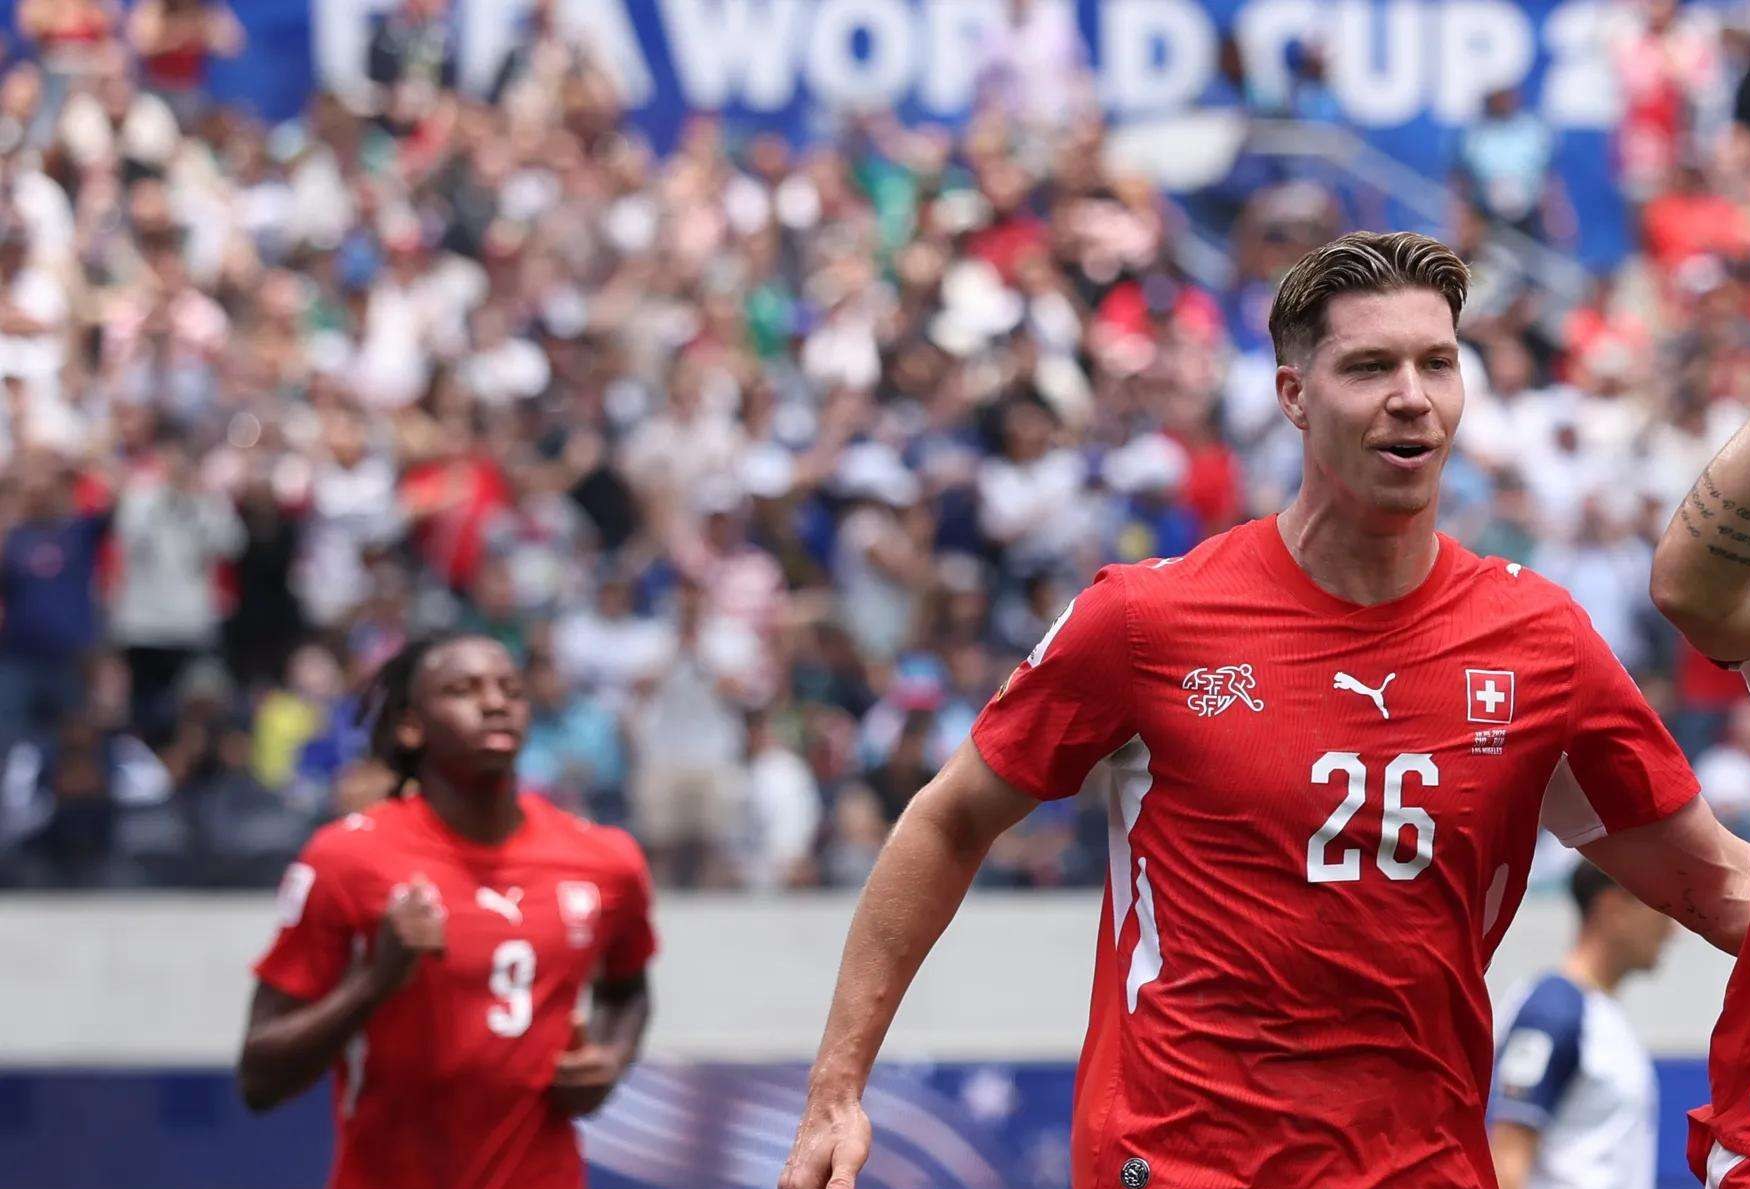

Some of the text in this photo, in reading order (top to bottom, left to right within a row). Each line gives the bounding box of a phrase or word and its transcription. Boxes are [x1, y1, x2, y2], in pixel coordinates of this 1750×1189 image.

[656, 0, 1218, 117] WORD
[1305, 751, 1440, 883] 26
[486, 939, 537, 1038] 9
